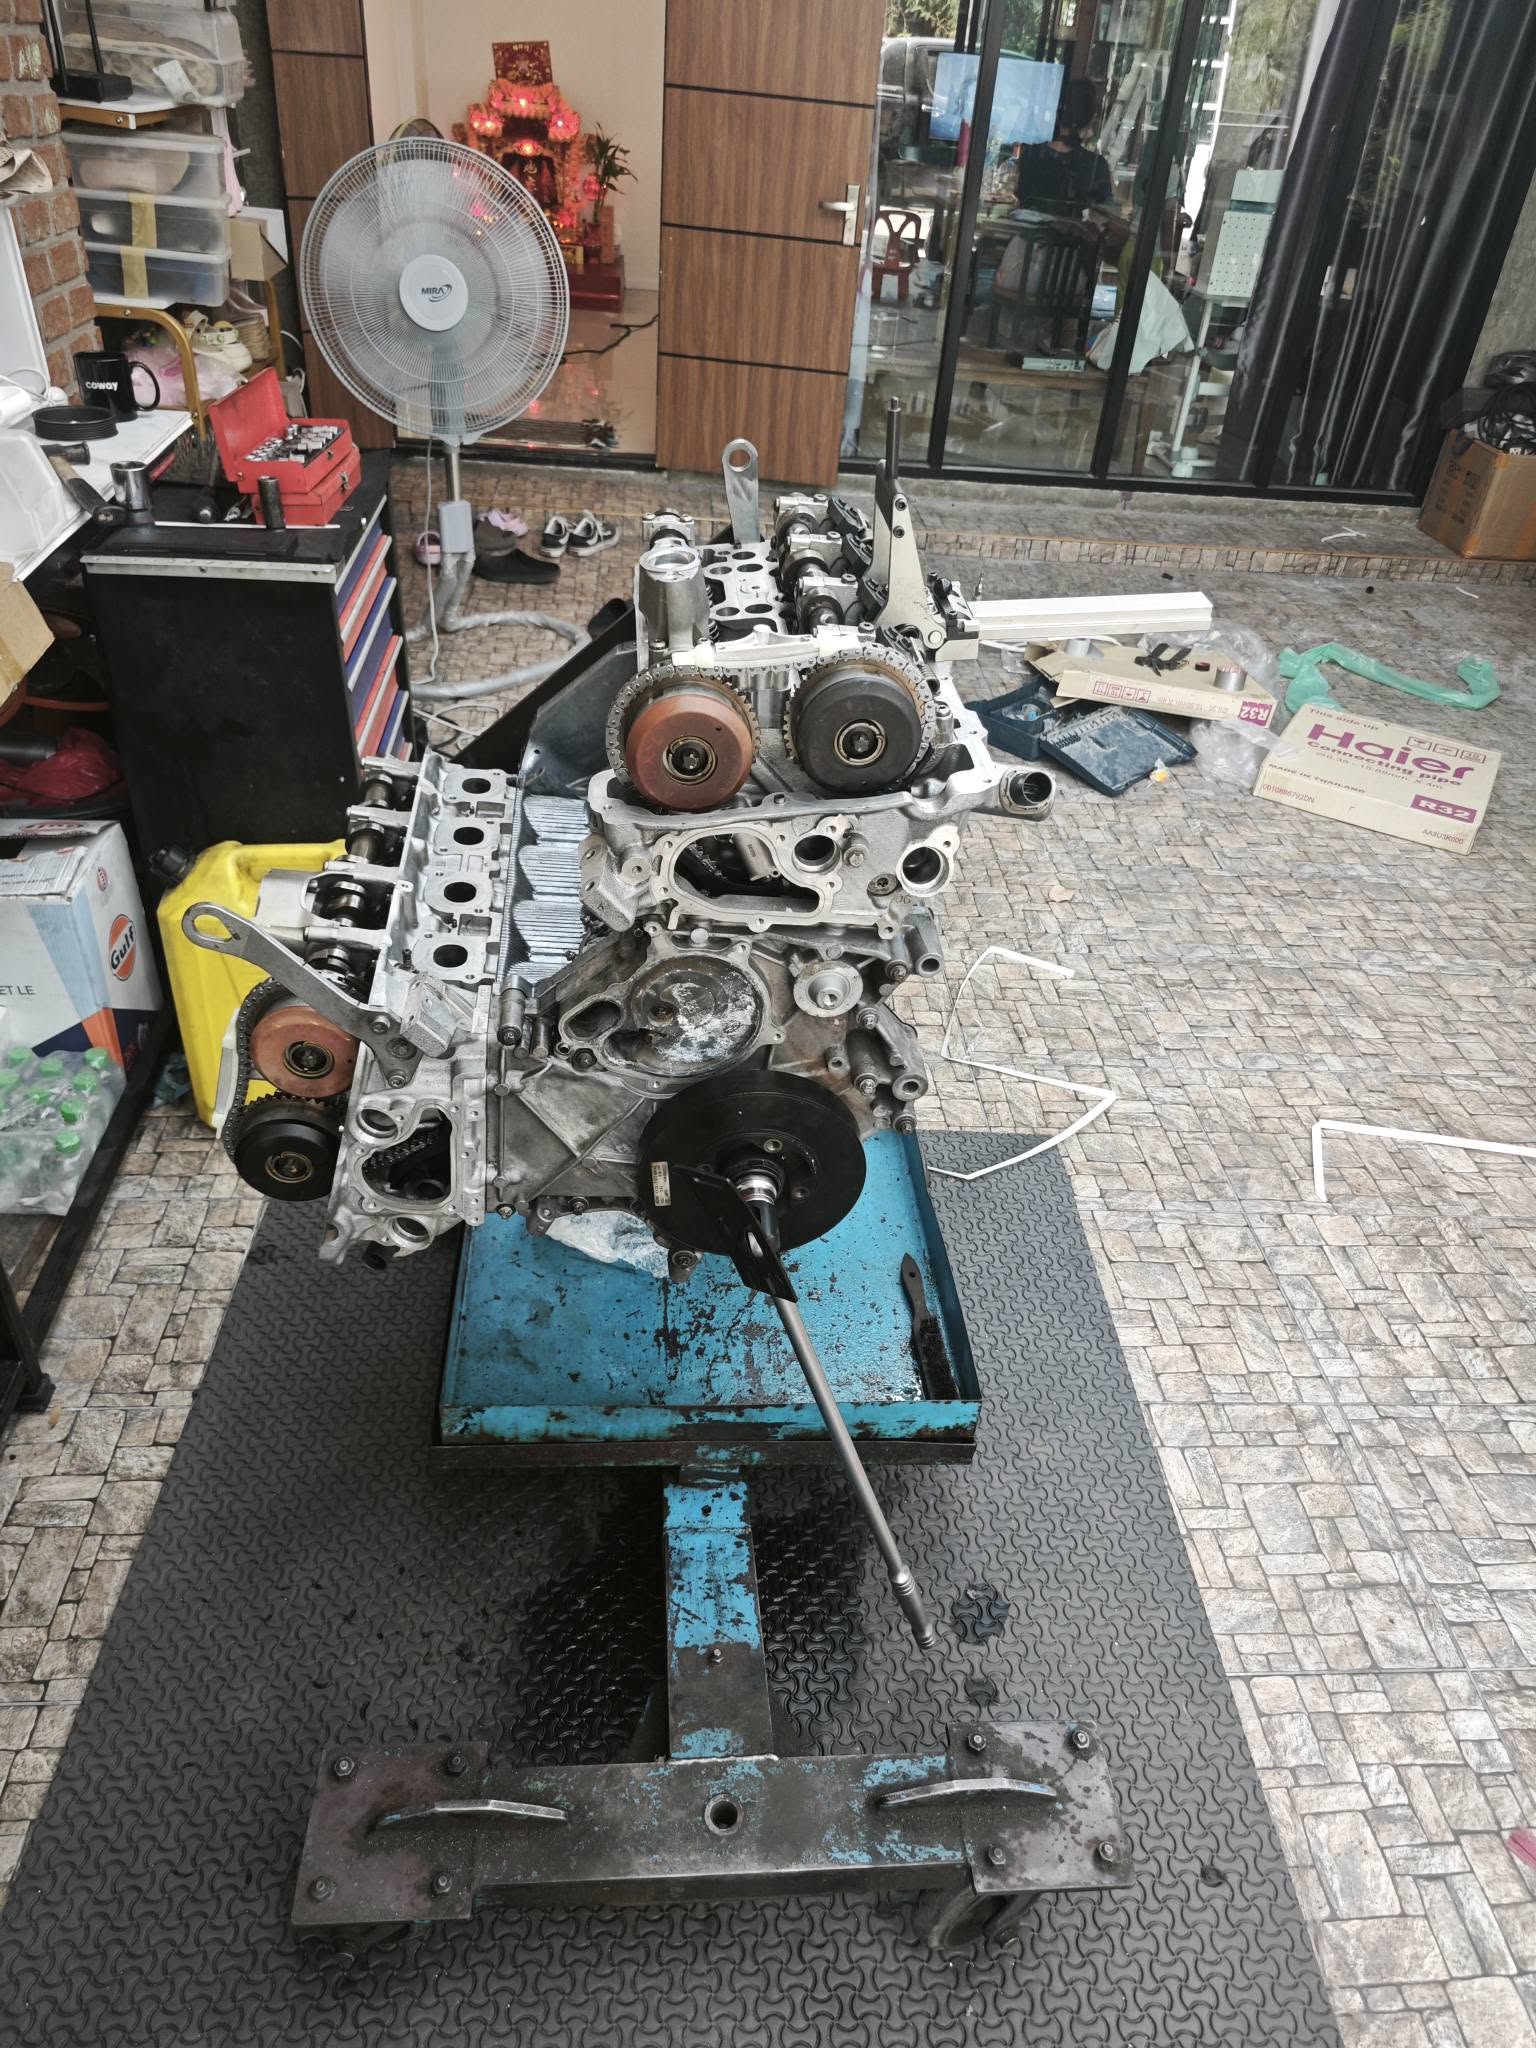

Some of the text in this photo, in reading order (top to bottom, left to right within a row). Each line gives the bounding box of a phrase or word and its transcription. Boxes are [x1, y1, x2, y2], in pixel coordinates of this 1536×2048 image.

[421, 287, 445, 295] MIRA
[86, 381, 118, 391] coway
[1240, 706, 1270, 721] R32
[1336, 714, 1361, 727] side
[1306, 723, 1475, 779] Haier
[1307, 741, 1462, 787] Connecting pipe
[1268, 763, 1366, 794] MADE IN THAILAND
[1418, 799, 1471, 820] R32
[110, 925, 135, 970] Gulf
[17, 985, 36, 995] LE
